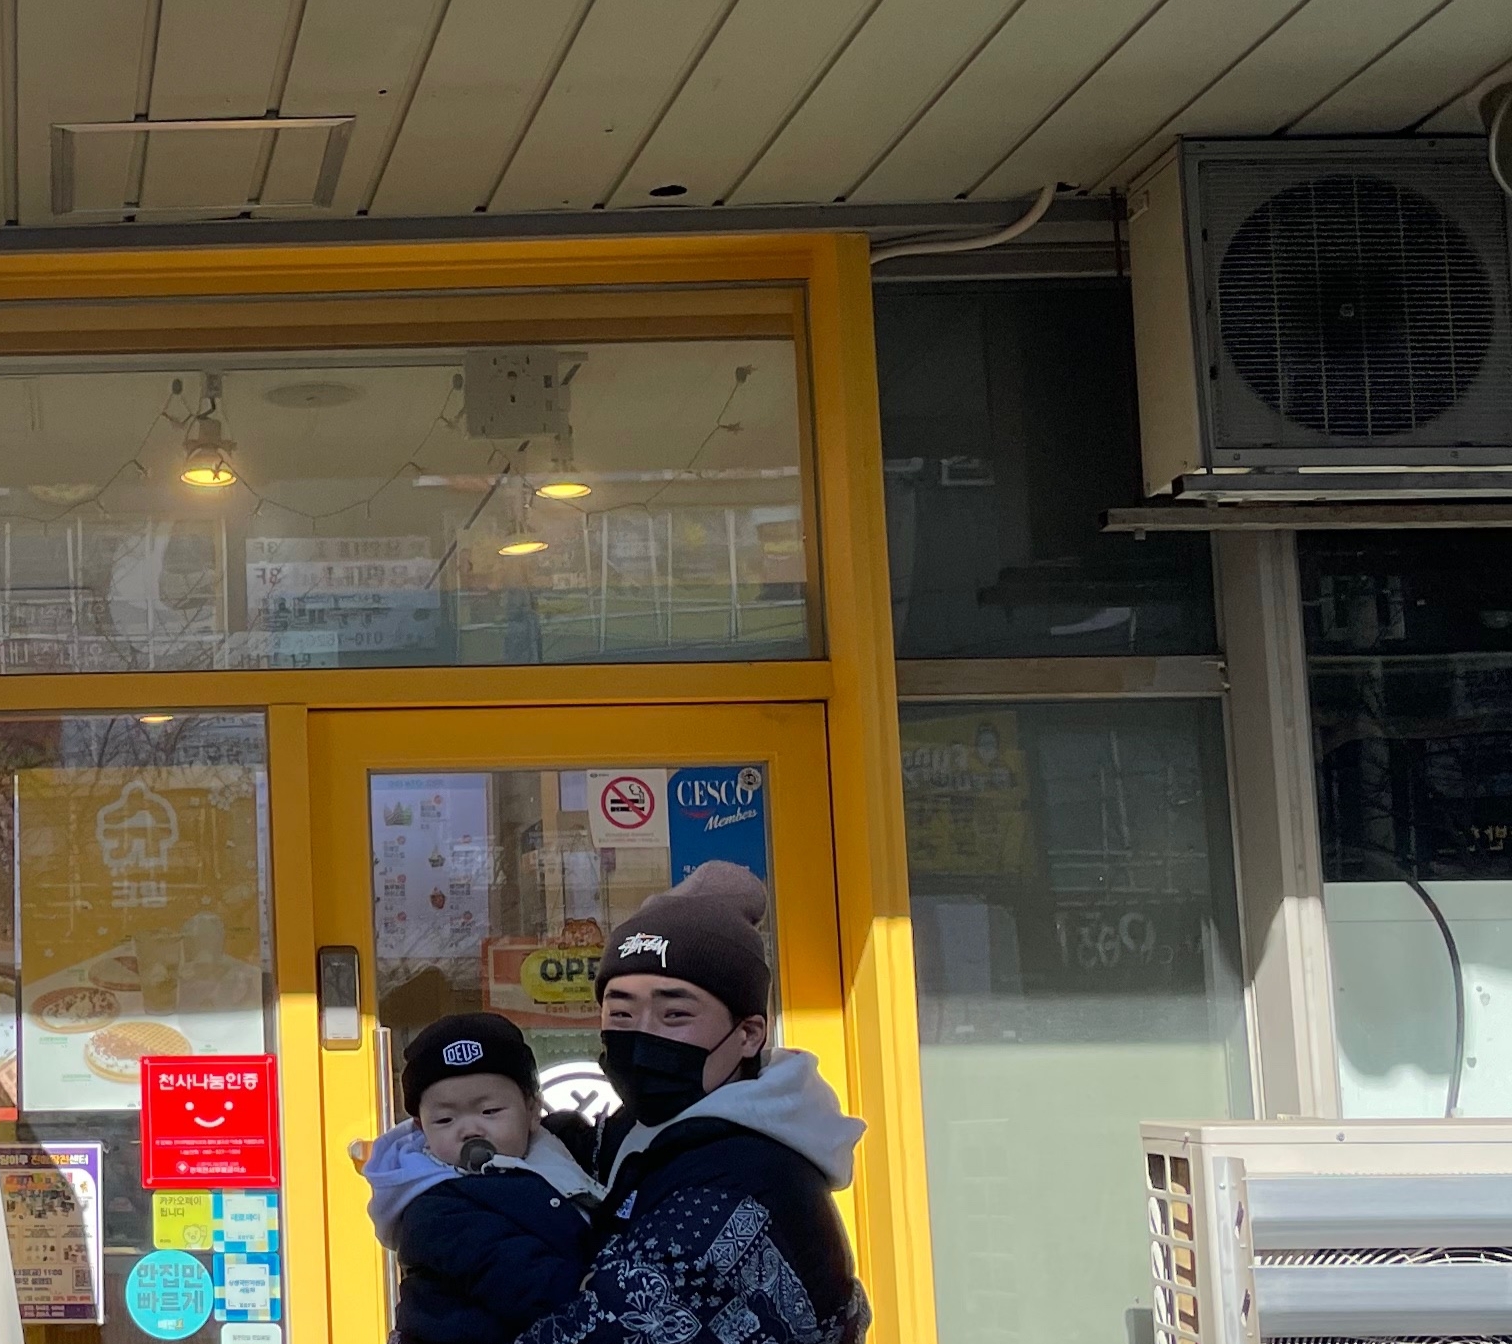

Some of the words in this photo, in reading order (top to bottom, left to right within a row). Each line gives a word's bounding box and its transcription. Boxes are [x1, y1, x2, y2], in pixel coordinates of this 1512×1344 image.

[677, 780, 753, 807] CESCO
[704, 807, 757, 832] Members
[540, 957, 600, 982] OPE
[447, 1043, 479, 1062] DEUS
[158, 1072, 259, 1091] 천사나눔인증
[160, 1196, 202, 1205] 카카오페이
[160, 1207, 185, 1217] 됩니다
[138, 1263, 205, 1288] 한집만
[138, 1291, 204, 1314] 빠르게
